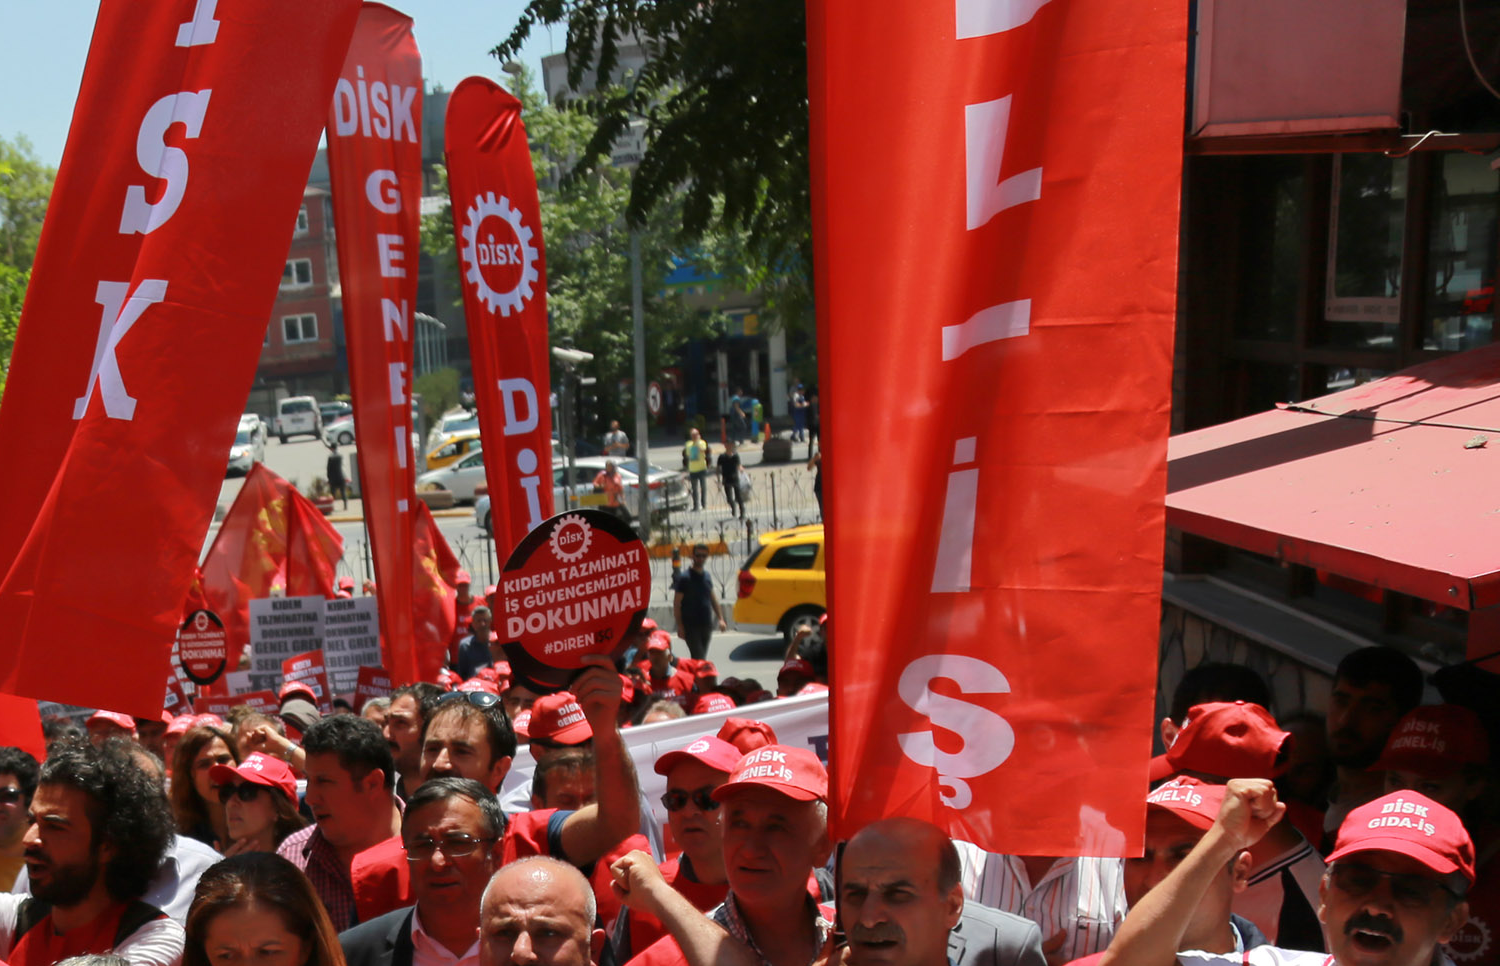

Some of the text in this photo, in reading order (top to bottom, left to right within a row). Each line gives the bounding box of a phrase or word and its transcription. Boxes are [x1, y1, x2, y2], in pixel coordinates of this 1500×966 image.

[334, 65, 418, 143] DİSK
[478, 234, 522, 265] DİSK
[559, 531, 584, 546] DİSK
[503, 549, 641, 594] KIDEM TAZMİNATI
[505, 568, 640, 614] İŞ GÜVENCEMİZDİR
[272, 600, 302, 611] KIDEM
[327, 600, 356, 611] KIDEM
[507, 586, 642, 639] DOKUNMA!
[257, 612, 318, 626] TAZMİNATINA
[325, 612, 371, 625] ZMİNATINA
[325, 625, 368, 638] OKUNMAK
[255, 638, 323, 654] GENEL GREV
[327, 636, 378, 651] NEL GREV
[182, 648, 226, 660] DOKUNMA!
[746, 750, 787, 767] DİSK
[1145, 789, 1202, 807] NEL-İŞ
[1381, 798, 1429, 817] DİSK
[1368, 816, 1435, 836] GIDA-İŞ
